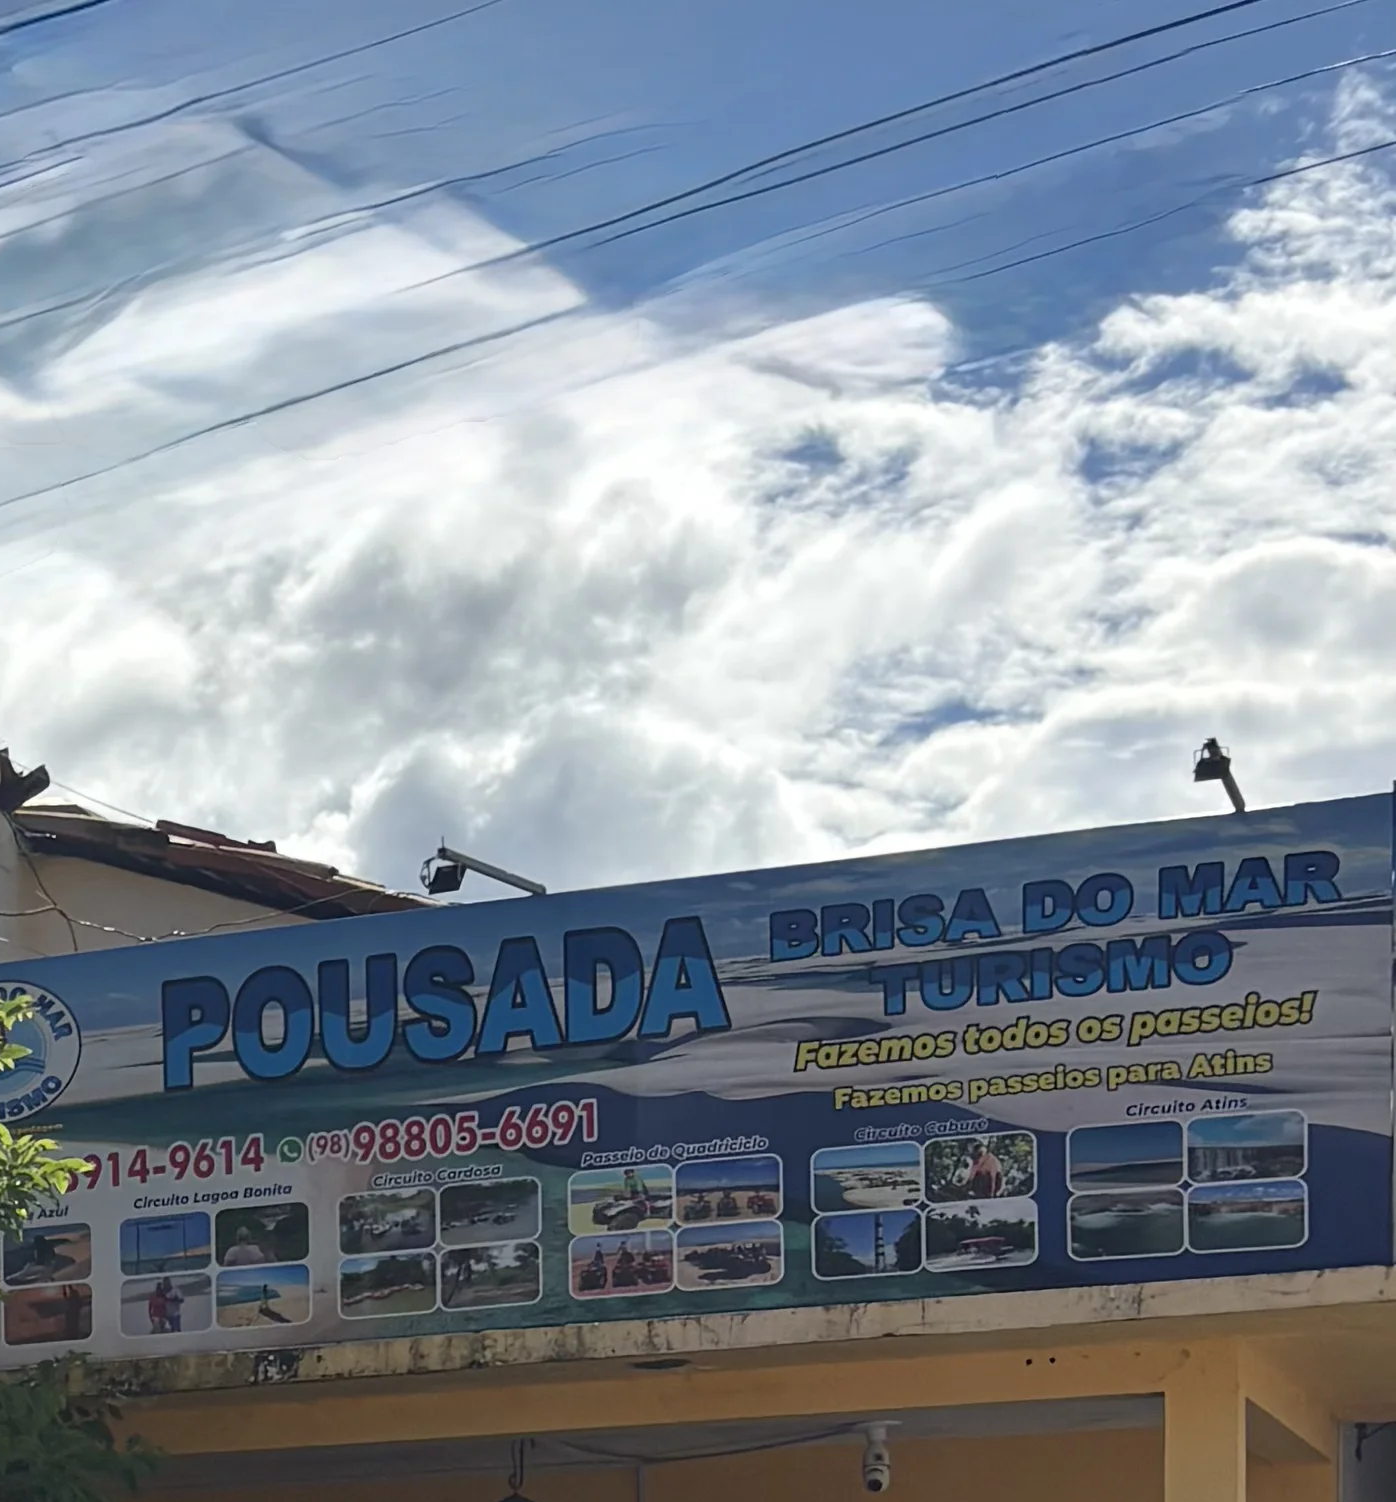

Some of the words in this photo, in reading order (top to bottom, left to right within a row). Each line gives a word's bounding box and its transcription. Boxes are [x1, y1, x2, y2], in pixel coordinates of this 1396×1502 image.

[770, 888, 1001, 962] BRISA
[1022, 872, 1134, 935] DO
[1158, 850, 1342, 920] MAR
[870, 930, 1232, 1018] TURISMO
[161, 914, 732, 1091] POUSADA
[795, 1028, 956, 1072] Fazemos
[962, 1016, 1070, 1058] todos
[1077, 1009, 1127, 1042] os
[1127, 989, 1319, 1048] passeios!
[833, 1078, 963, 1111] Fazemos
[968, 1063, 1101, 1104] passeios
[1107, 1059, 1181, 1091] para
[1187, 1050, 1273, 1080] Atins
[1126, 1101, 1196, 1118] Circuito
[1201, 1096, 1248, 1111] Atins
[581, 1148, 645, 1167] Passeio
[647, 1145, 669, 1160] de
[672, 1137, 768, 1160] Quadriciclo
[855, 1123, 922, 1142] Circuito
[66, 1134, 264, 1193] 914-9614
[373, 1171, 433, 1188] Circuito
[437, 1165, 501, 1182] Cardosa
[38, 1206, 68, 1220] Azul
[133, 1193, 190, 1209] Circuito
[193, 1189, 239, 1205] Lagoa
[243, 1183, 292, 1199] Bonita
